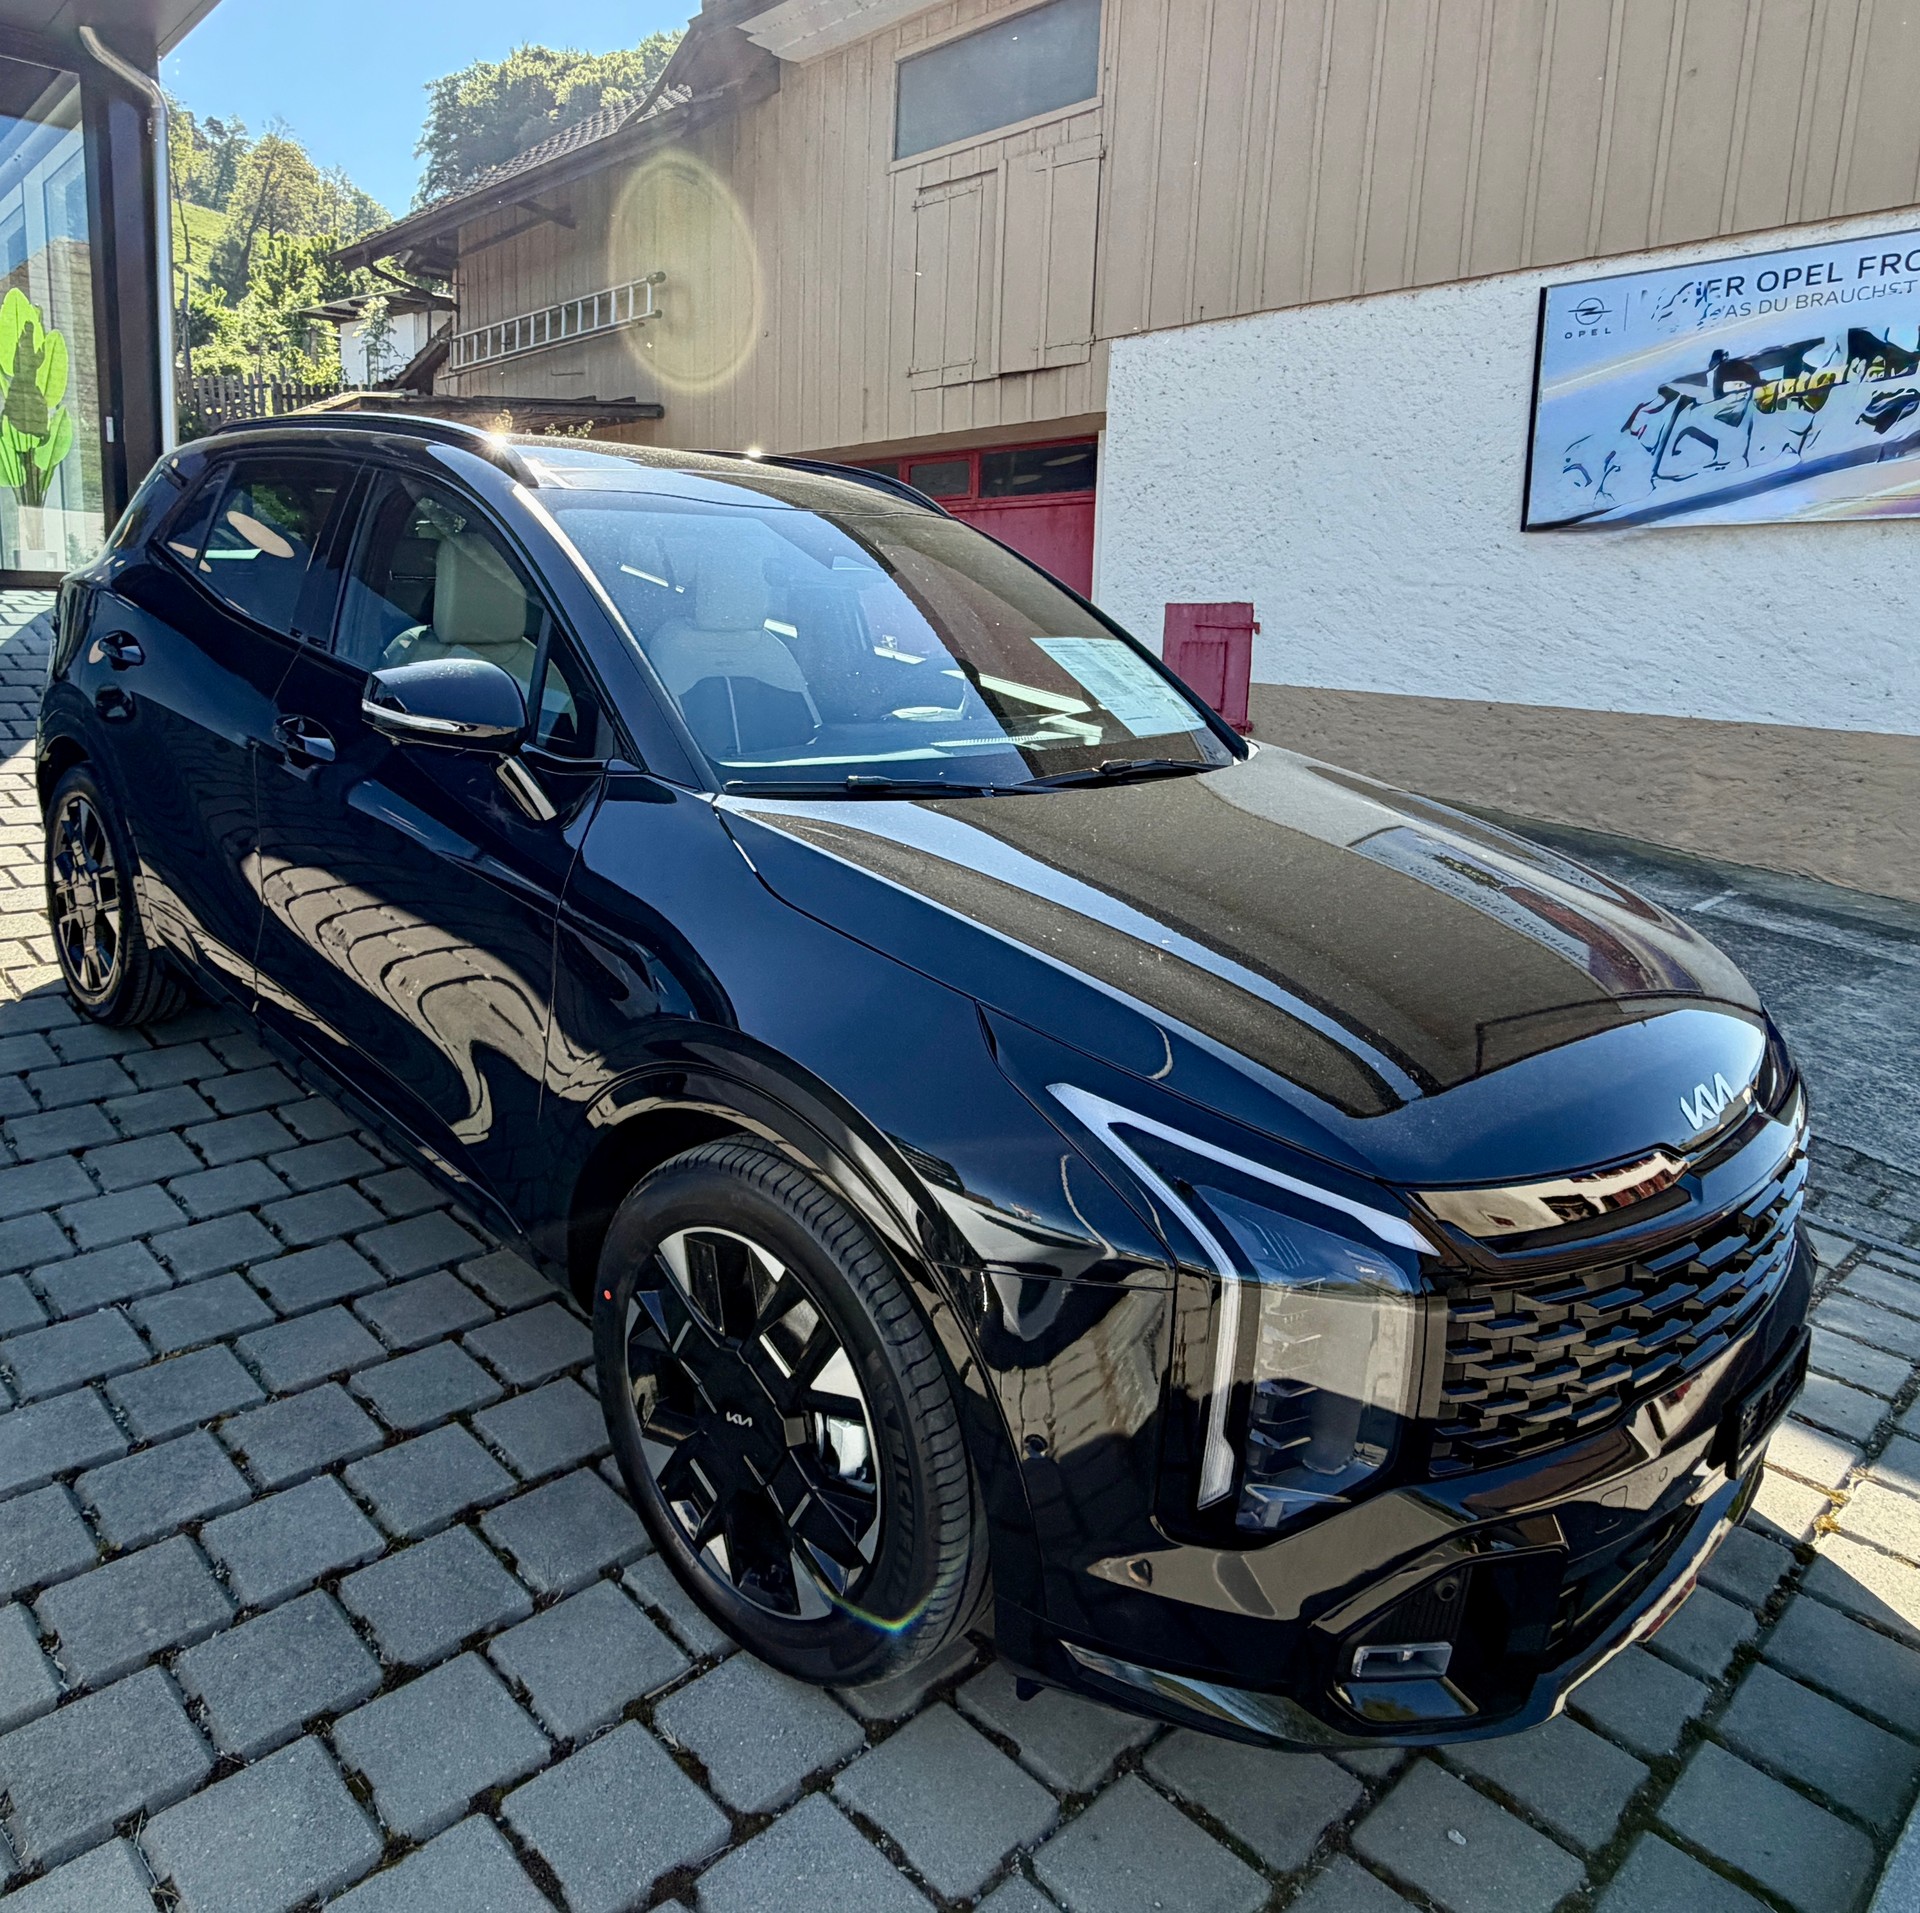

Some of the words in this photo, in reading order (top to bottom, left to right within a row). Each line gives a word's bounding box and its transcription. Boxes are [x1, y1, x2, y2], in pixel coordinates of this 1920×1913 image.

[1756, 261, 1844, 293] OPEL
[1758, 297, 1788, 315] DU
[1564, 327, 1612, 339] OPEL
[1680, 1071, 1735, 1131] KIA
[725, 1411, 753, 1428] KIA
